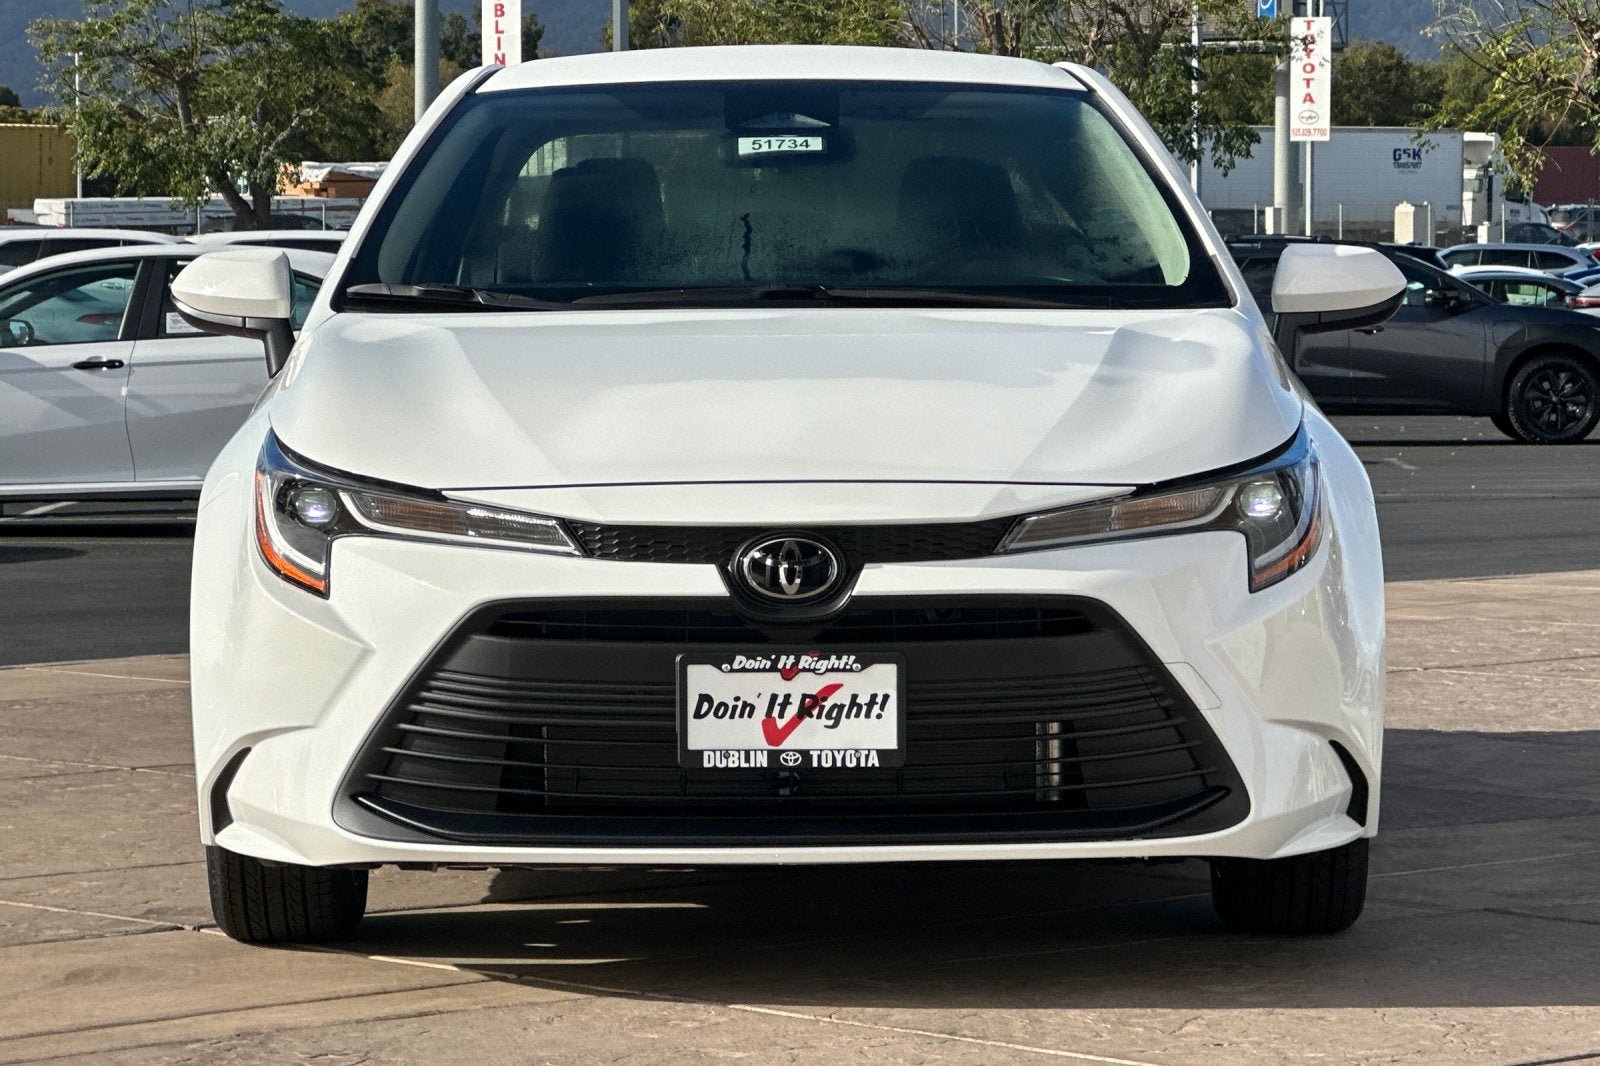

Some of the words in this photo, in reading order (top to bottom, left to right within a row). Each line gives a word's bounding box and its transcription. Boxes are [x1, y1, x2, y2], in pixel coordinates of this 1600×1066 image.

[494, 0, 506, 67] BLIN
[1302, 20, 1315, 104] TOYOTA
[751, 139, 811, 151] 51734
[1393, 147, 1422, 161] GSK
[732, 654, 776, 670] Doin'
[777, 655, 796, 670] It
[798, 655, 857, 675] Right!
[693, 693, 762, 720] Doin'
[764, 693, 793, 720] It
[796, 693, 891, 730] Right!
[703, 750, 768, 768] DUBLIN
[809, 750, 880, 768] TOYOTA
